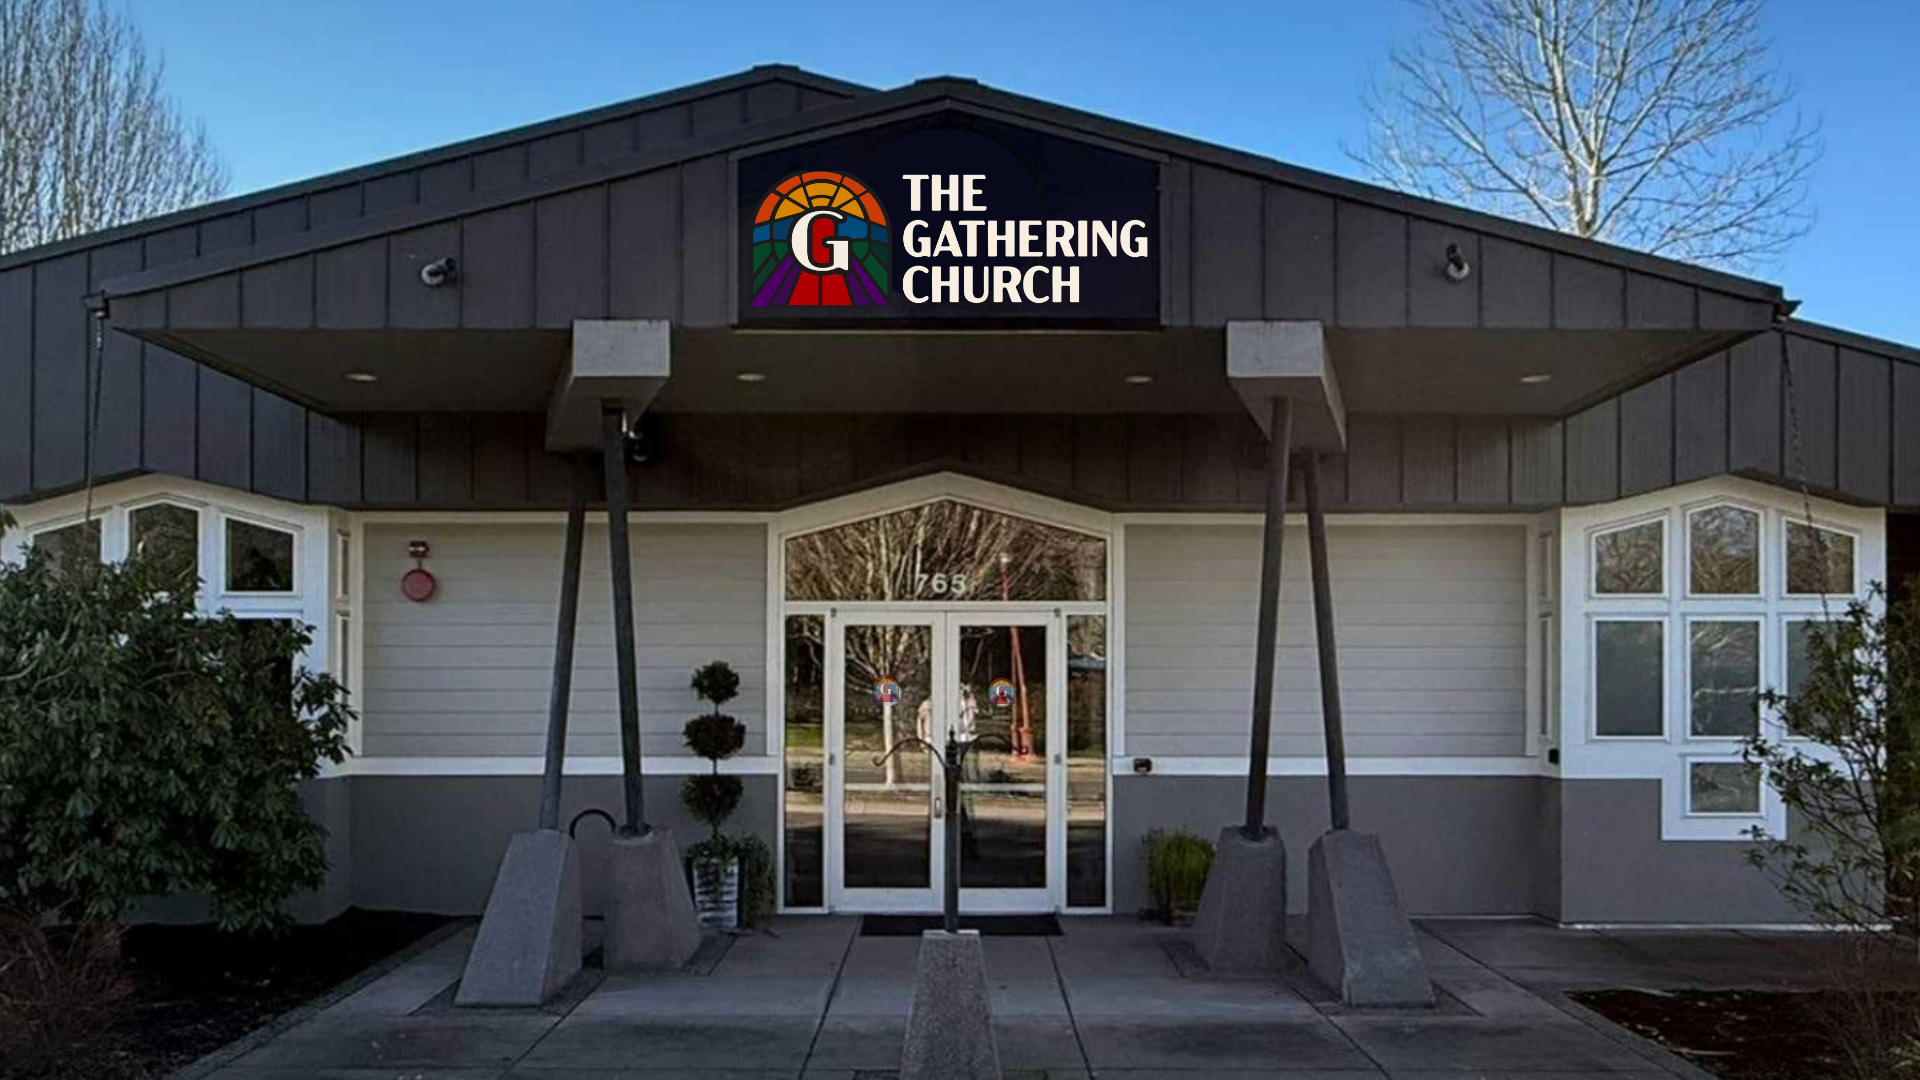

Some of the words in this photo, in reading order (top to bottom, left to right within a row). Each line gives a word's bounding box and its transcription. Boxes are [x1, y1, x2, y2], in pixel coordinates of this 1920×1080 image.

[903, 174, 988, 212] THE
[791, 210, 849, 272] G
[902, 219, 1149, 258] GATHERING
[902, 265, 1080, 304] CHURCH
[916, 573, 966, 593] 765
